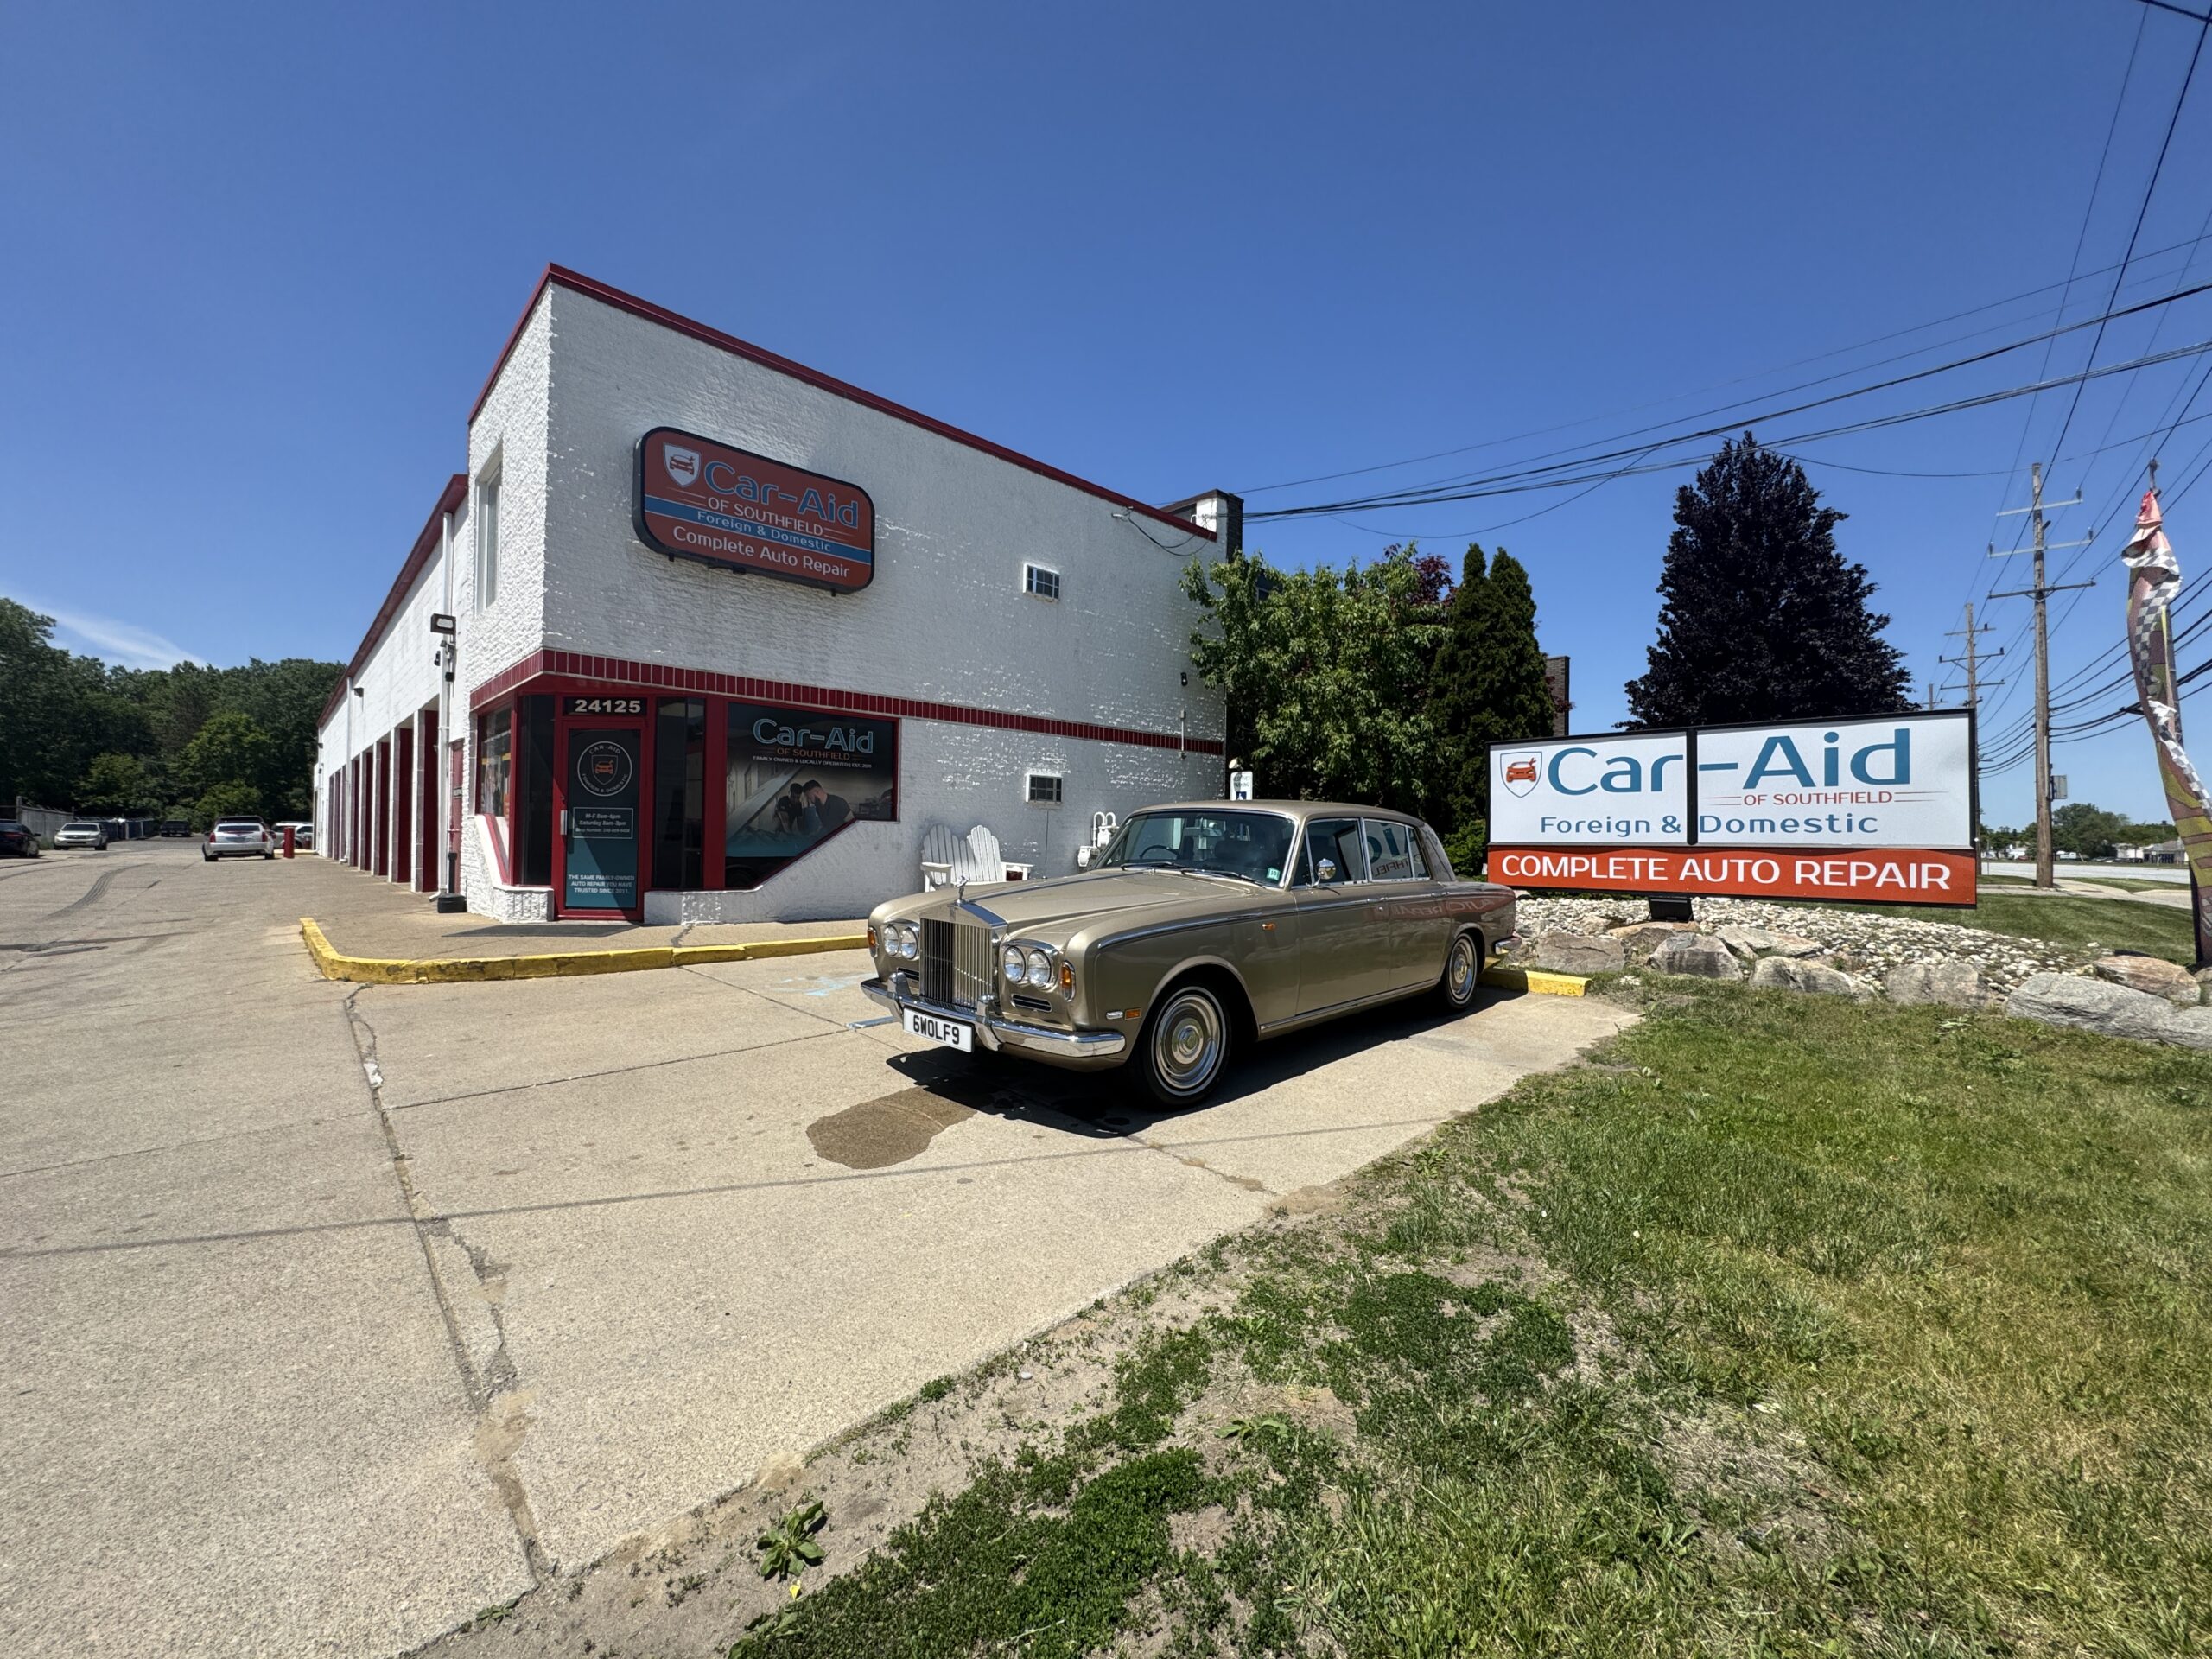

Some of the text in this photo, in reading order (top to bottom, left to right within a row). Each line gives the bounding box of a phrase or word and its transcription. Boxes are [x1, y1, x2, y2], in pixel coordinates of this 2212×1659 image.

[704, 461, 858, 529] Car-Aid
[697, 511, 831, 553] Foreign & Domestic
[708, 497, 823, 537] OF SOUTHFIELD
[673, 526, 849, 578] Complete Auto Repair
[575, 699, 641, 713] 24125
[588, 745, 621, 754] CAR-AID
[753, 718, 874, 753] Car-Aid
[777, 747, 850, 761] OF SOUTHFIELD
[1548, 728, 1911, 797] Car-Aid
[1744, 791, 1892, 806] OF SOUTHFIELD
[1541, 812, 1878, 837] Foreign & Domestic
[1502, 854, 1950, 891] COMPLETE AUTO REPAIR
